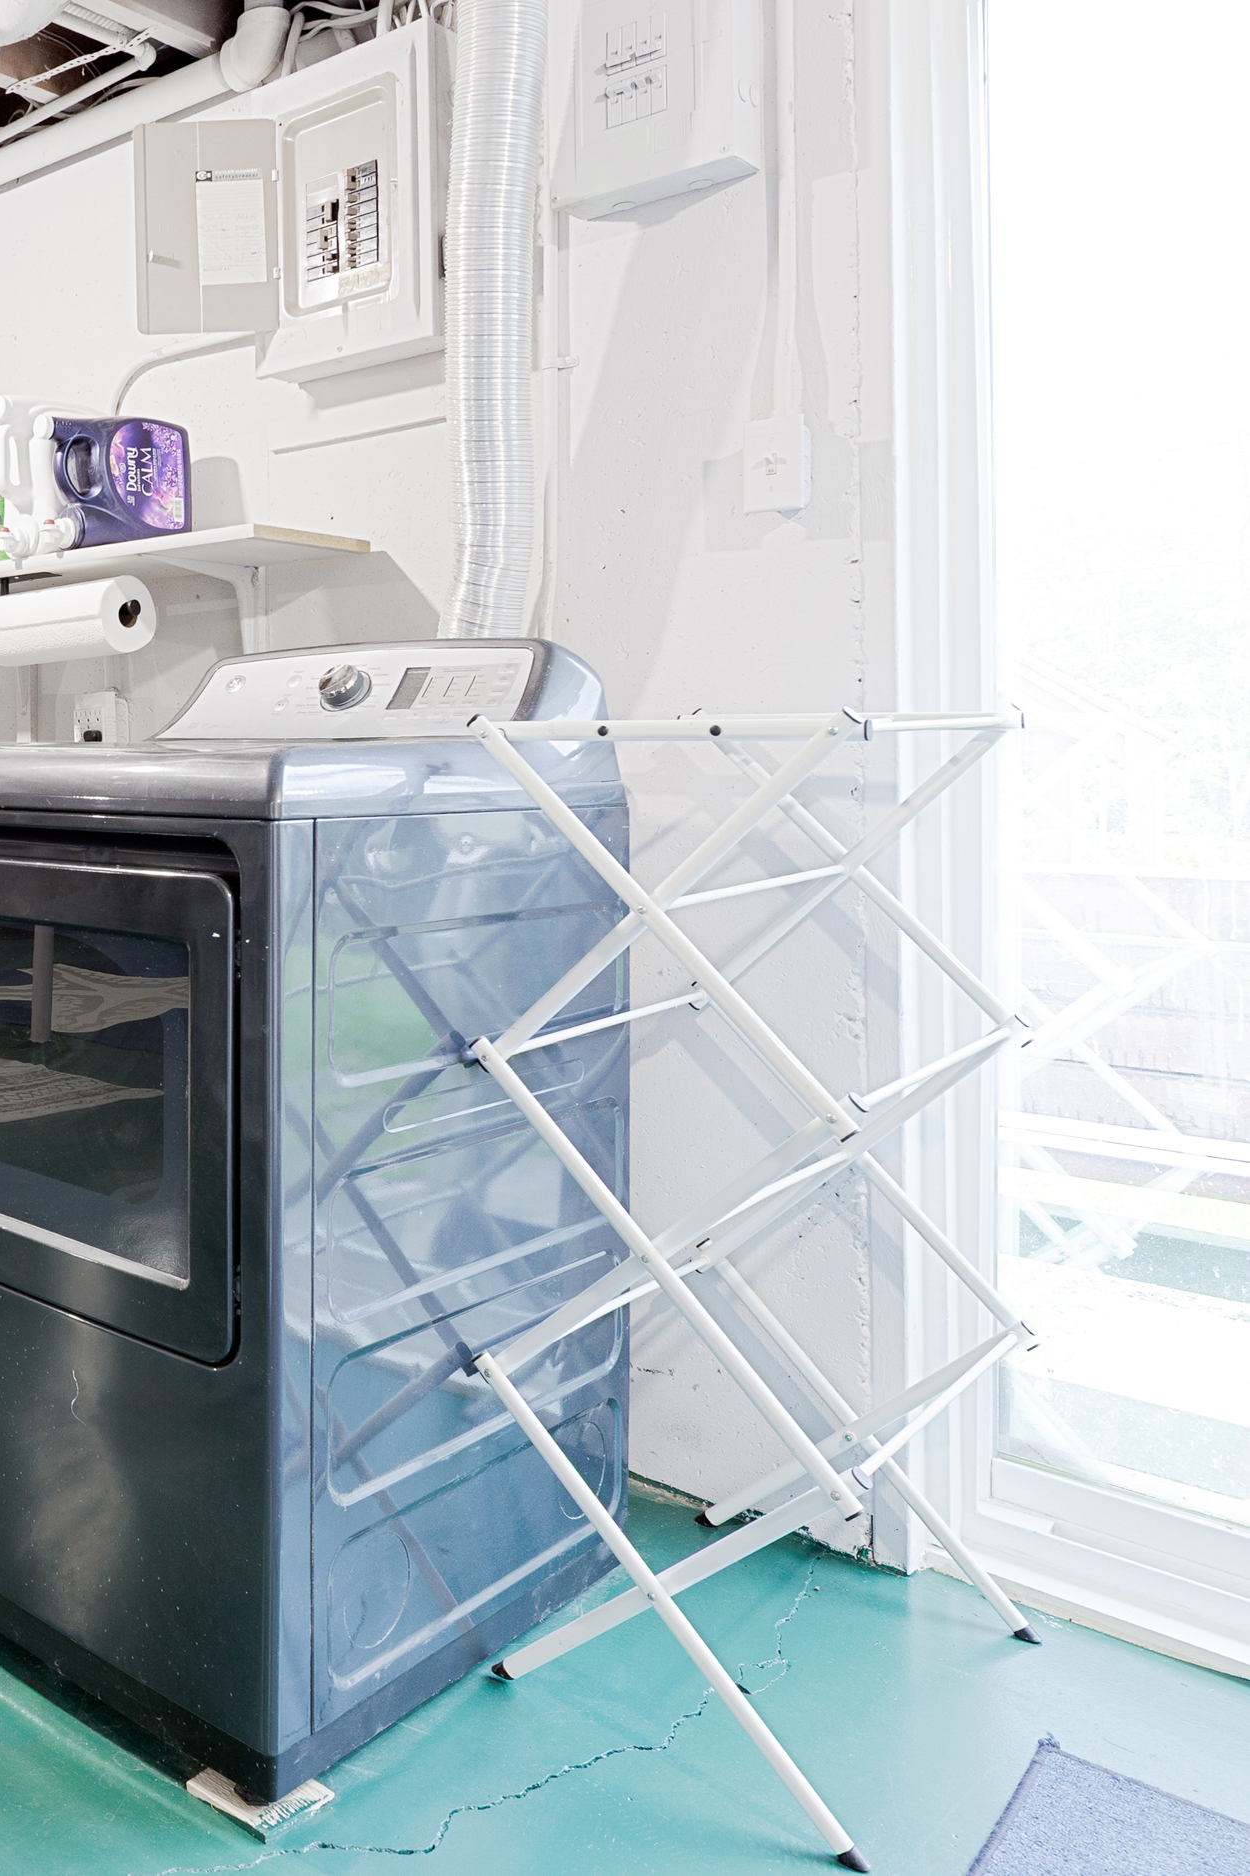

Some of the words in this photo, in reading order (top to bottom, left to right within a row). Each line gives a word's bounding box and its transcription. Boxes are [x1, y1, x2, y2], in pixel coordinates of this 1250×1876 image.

[359, 174, 376, 186] MAIN
[126, 447, 139, 492] Downy
[140, 447, 154, 496] CALM
